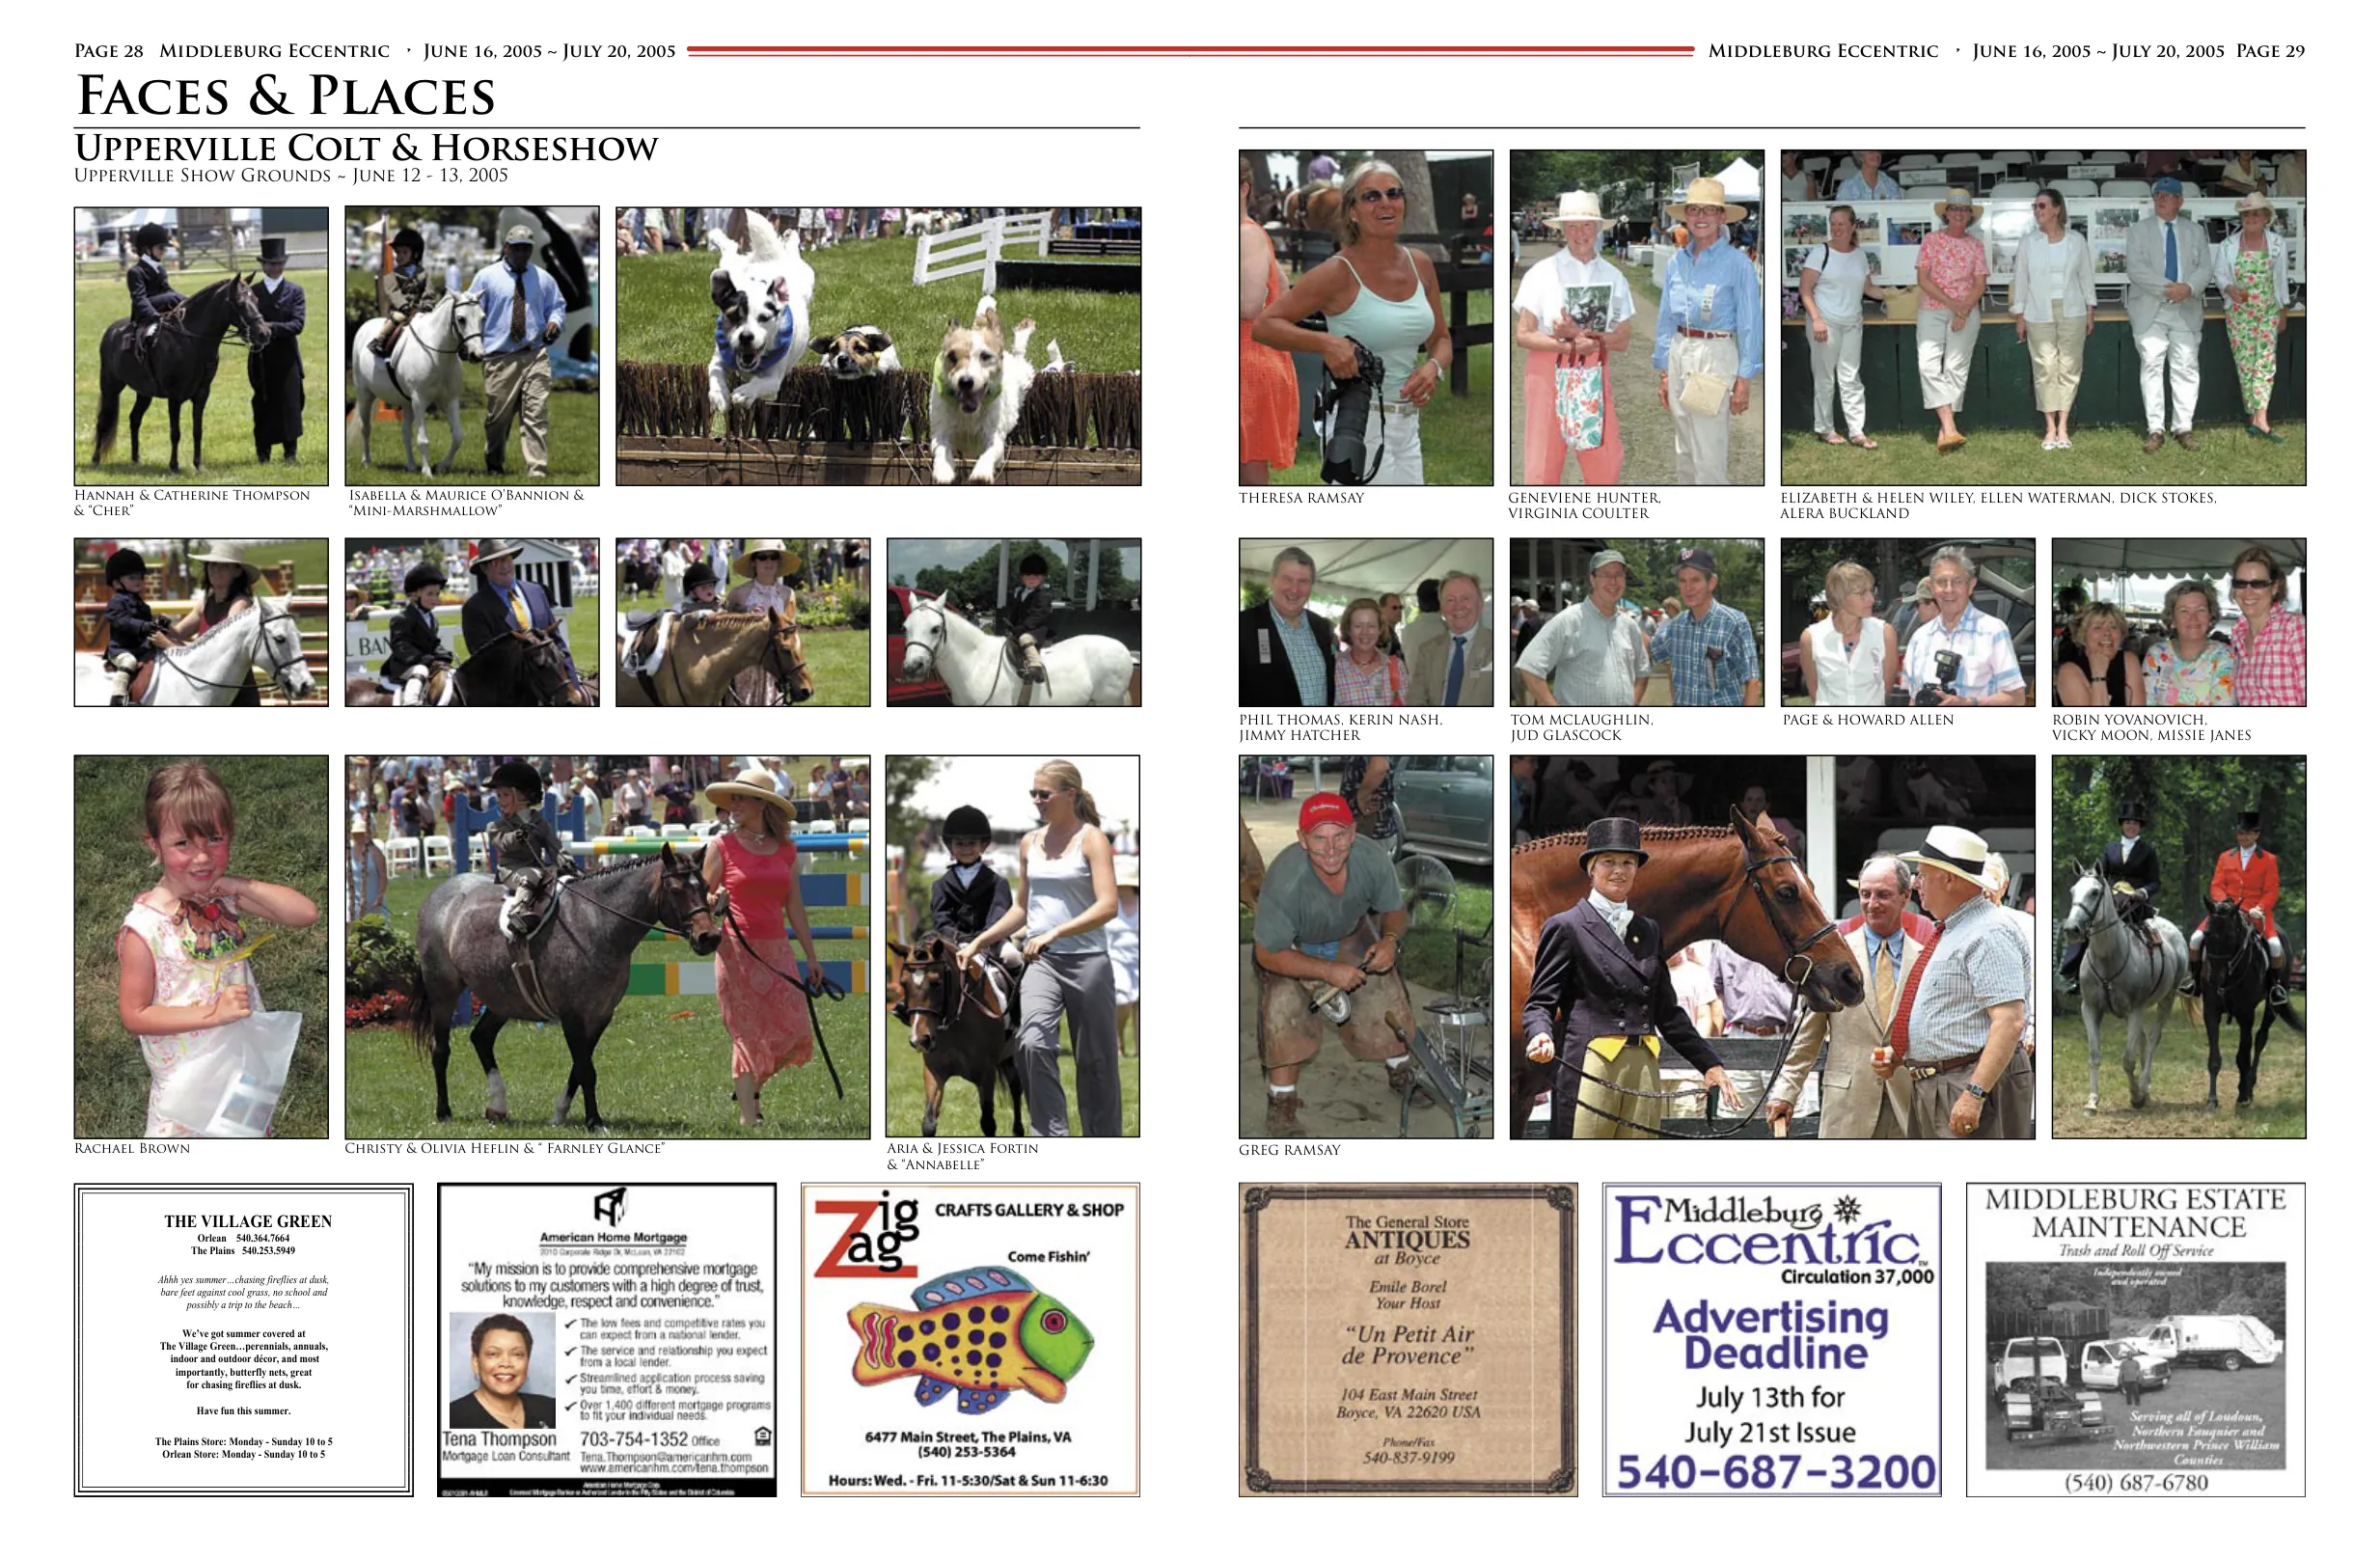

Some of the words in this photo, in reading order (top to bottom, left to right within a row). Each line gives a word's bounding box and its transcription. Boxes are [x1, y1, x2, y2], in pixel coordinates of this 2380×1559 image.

[74, 42, 119, 58] PAGE
[123, 44, 144, 59] 28
[159, 42, 283, 58] MIDDLEBURG
[288, 42, 390, 58] ECCENTRIC
[423, 42, 468, 63] JUNE
[475, 44, 498, 60] 16,
[503, 44, 542, 58] 2005
[561, 42, 603, 63] JULY
[607, 44, 631, 60] 20,
[636, 44, 676, 58] 2005
[1709, 42, 1831, 58] MIDDLEBURG
[1837, 42, 1939, 58] ECCENTRIC
[1972, 42, 2017, 63] JUNE
[2023, 44, 2046, 60] 16,
[2051, 44, 2092, 58] 2005
[2111, 42, 2152, 63] JULY
[2156, 44, 2180, 60] 20,
[2185, 44, 2225, 59] 2005
[2236, 42, 2281, 58] PAGE
[2285, 44, 2306, 59] 29
[77, 73, 229, 116] FACES
[249, 72, 295, 116] &
[309, 73, 495, 116] PLACES
[73, 133, 276, 162] UPPERVILLE
[287, 132, 381, 162] COLT
[392, 132, 424, 162] &
[430, 133, 660, 162] HORSESHOW
[74, 167, 175, 183] UPPERVILLE
[180, 167, 235, 182] SHOW
[240, 167, 331, 183] GROUNDS
[352, 167, 396, 186] JUNE
[402, 167, 422, 182] 12
[440, 167, 463, 183] 13,
[468, 167, 508, 183] 2005
[74, 489, 134, 501] HANNAH
[139, 489, 150, 501] &
[153, 488, 229, 501] CATHERINE
[233, 489, 310, 501] THOMPSON
[349, 489, 407, 501] ISABELLA
[410, 489, 422, 501] &
[425, 489, 487, 501] MAURICE
[573, 488, 585, 501] &
[1238, 491, 1303, 504] THERESA
[1307, 491, 1365, 504] RAMSAY
[1508, 491, 1592, 504] GENEVIENE
[1597, 492, 1661, 505] HUNTER,
[1781, 492, 1857, 504] ELIZABETH
[1862, 491, 1874, 504] &
[1877, 492, 1925, 504] HELEN
[1929, 492, 1976, 504] WILEY,
[1981, 492, 2023, 504] ELLEN
[2027, 492, 2115, 505] WATERMAN,
[2120, 491, 2158, 504] DICK
[2161, 491, 2217, 505] STOKES,
[73, 504, 85, 516] &
[1508, 506, 1578, 519] VIRGINIA
[1581, 506, 1650, 519] COULTER
[1780, 507, 1825, 519] ALERA
[1829, 506, 1910, 519] BUCKLAND
[359, 637, 393, 656] BAN
[1240, 714, 1273, 725] PHIL
[1276, 713, 1344, 726] THOMAS,
[1349, 714, 1393, 725] KERIN
[1399, 713, 1443, 726] NASH,
[1510, 713, 1545, 725] TOM
[1549, 713, 1654, 726] MCLAUGHLIN,
[1783, 713, 1819, 725] PAGE
[1822, 713, 1834, 725] &
[1838, 713, 1905, 725] HOWARD
[1909, 714, 1954, 725] ALLEN
[2053, 713, 2100, 725] ROBIN
[2104, 713, 2207, 726] YOVANOVICH,
[1239, 729, 1286, 744] JIMMY
[1291, 728, 1361, 741] HATCHER
[1511, 729, 1539, 744] JUD
[1543, 728, 1623, 741] GLASCOCK
[2052, 728, 2096, 741] VICKY
[2100, 728, 2153, 742] MOON,
[2157, 728, 2205, 741] MISSIE
[2209, 728, 2252, 744] JANES
[74, 1142, 135, 1154] RACHAEL
[140, 1142, 190, 1154] BROWN
[344, 1141, 403, 1154] CHRISTY
[406, 1141, 418, 1154] &
[421, 1141, 467, 1154] OLIVIA
[471, 1142, 519, 1154] HEFLIN
[523, 1142, 535, 1154] &
[547, 1142, 604, 1154] FARNLEY
[887, 1142, 919, 1154] ARIA
[922, 1141, 934, 1154] &
[937, 1142, 986, 1157] JESSICA
[990, 1142, 1039, 1154] FORTIN
[1239, 1143, 1279, 1156] GREG
[1284, 1143, 1341, 1156] RAMSAY
[887, 1158, 898, 1170] &
[1985, 1188, 2177, 1211] MIDDLEBURG
[2187, 1188, 2287, 1210] ESTATE
[935, 1203, 993, 1217] CRAFTS
[995, 1203, 1065, 1217] GALLERY
[1066, 1203, 1081, 1217] &
[1081, 1203, 1125, 1217] SHOP
[1664, 1195, 1822, 1230] Middleburg
[164, 1215, 198, 1228] THE
[201, 1214, 273, 1228] VILLAGE
[277, 1214, 333, 1228] GREEN
[2032, 1216, 2247, 1239] MAINTENANCE
[1614, 1195, 1921, 1265] Eccentric
[197, 1233, 227, 1243] Orlean
[235, 1233, 290, 1243] 540.364.7664
[540, 1232, 594, 1243] American
[597, 1232, 631, 1243] Home
[634, 1232, 688, 1245] Mortgage
[1345, 1230, 1470, 1253] ANTIQUES
[190, 1245, 208, 1255] The
[209, 1245, 235, 1255] Plains
[241, 1245, 296, 1255] 540.253.5949
[496, 1264, 539, 1275] mission
[569, 1263, 611, 1277] provide
[613, 1262, 700, 1277] comprehensive
[1781, 1269, 1872, 1284] Circulation
[1874, 1269, 1935, 1286] 37,000
[1377, 1297, 1406, 1310] Your
[1409, 1297, 1441, 1309] Host
[1654, 1299, 1889, 1339] Advertising
[217, 1354, 252, 1363] outdoor
[253, 1354, 280, 1364] décor,
[1685, 1335, 1869, 1369] Deadline
[1342, 1388, 1365, 1402] 104
[1369, 1388, 1398, 1401] East
[1401, 1388, 1436, 1401] Main
[1439, 1388, 1478, 1401] Street
[580, 1431, 689, 1447] 703-754-1352
[1797, 1421, 1856, 1443] Issue
[442, 1431, 478, 1447] Tena
[480, 1430, 557, 1449] Thompson
[2113, 1438, 2190, 1451] Northwestern
[918, 1446, 952, 1459] (540)
[954, 1446, 1017, 1458] 253-5364
[1363, 1451, 1455, 1464] 540-837-9199
[1618, 1454, 1936, 1490] 540-687-3200
[2065, 1473, 2113, 1494] (540)
[2120, 1473, 2209, 1492] 687-6780
